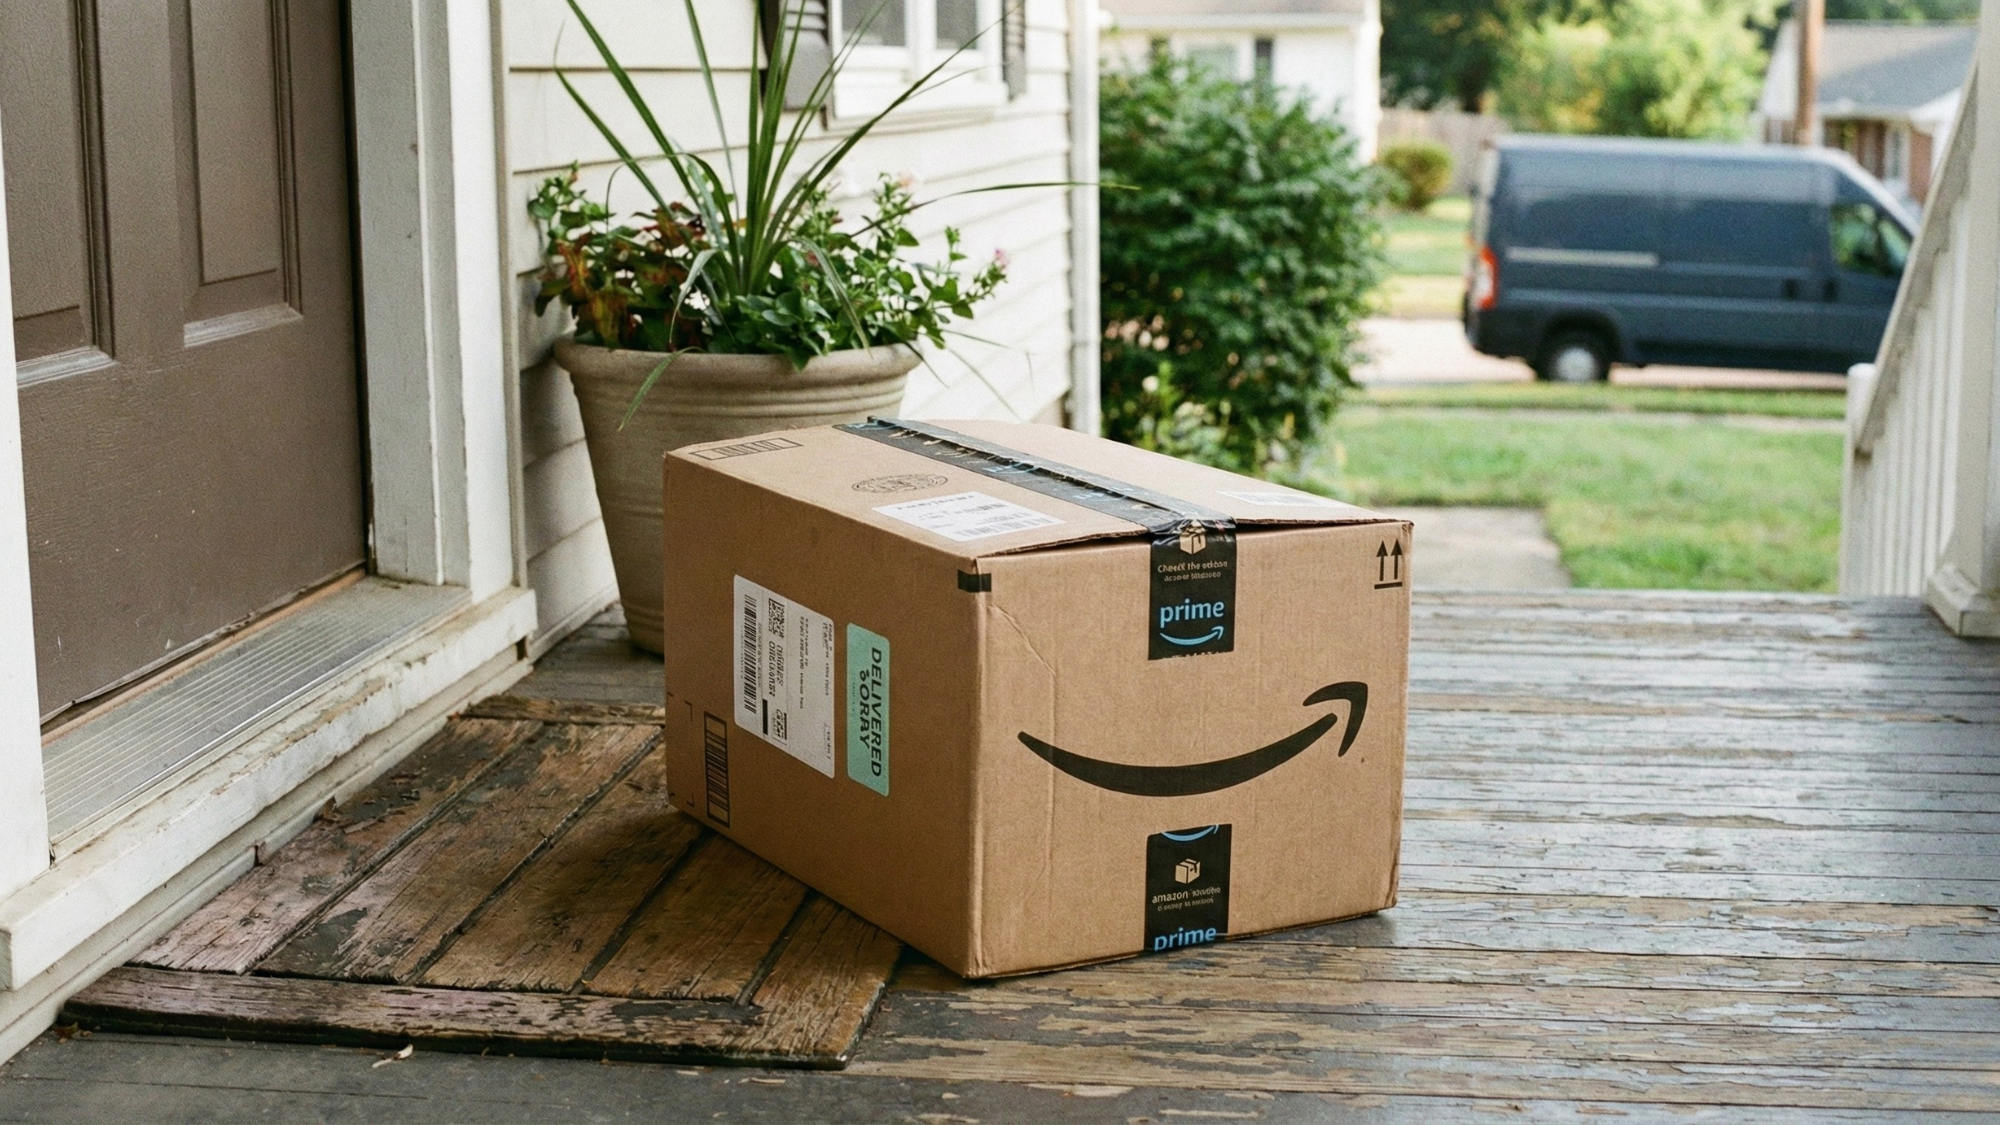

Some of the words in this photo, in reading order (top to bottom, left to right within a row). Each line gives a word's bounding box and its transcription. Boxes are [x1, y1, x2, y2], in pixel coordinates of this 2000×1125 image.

[1160, 598, 1225, 628] prime
[871, 647, 882, 777] DELIVERED
[1154, 927, 1217, 951] prime
